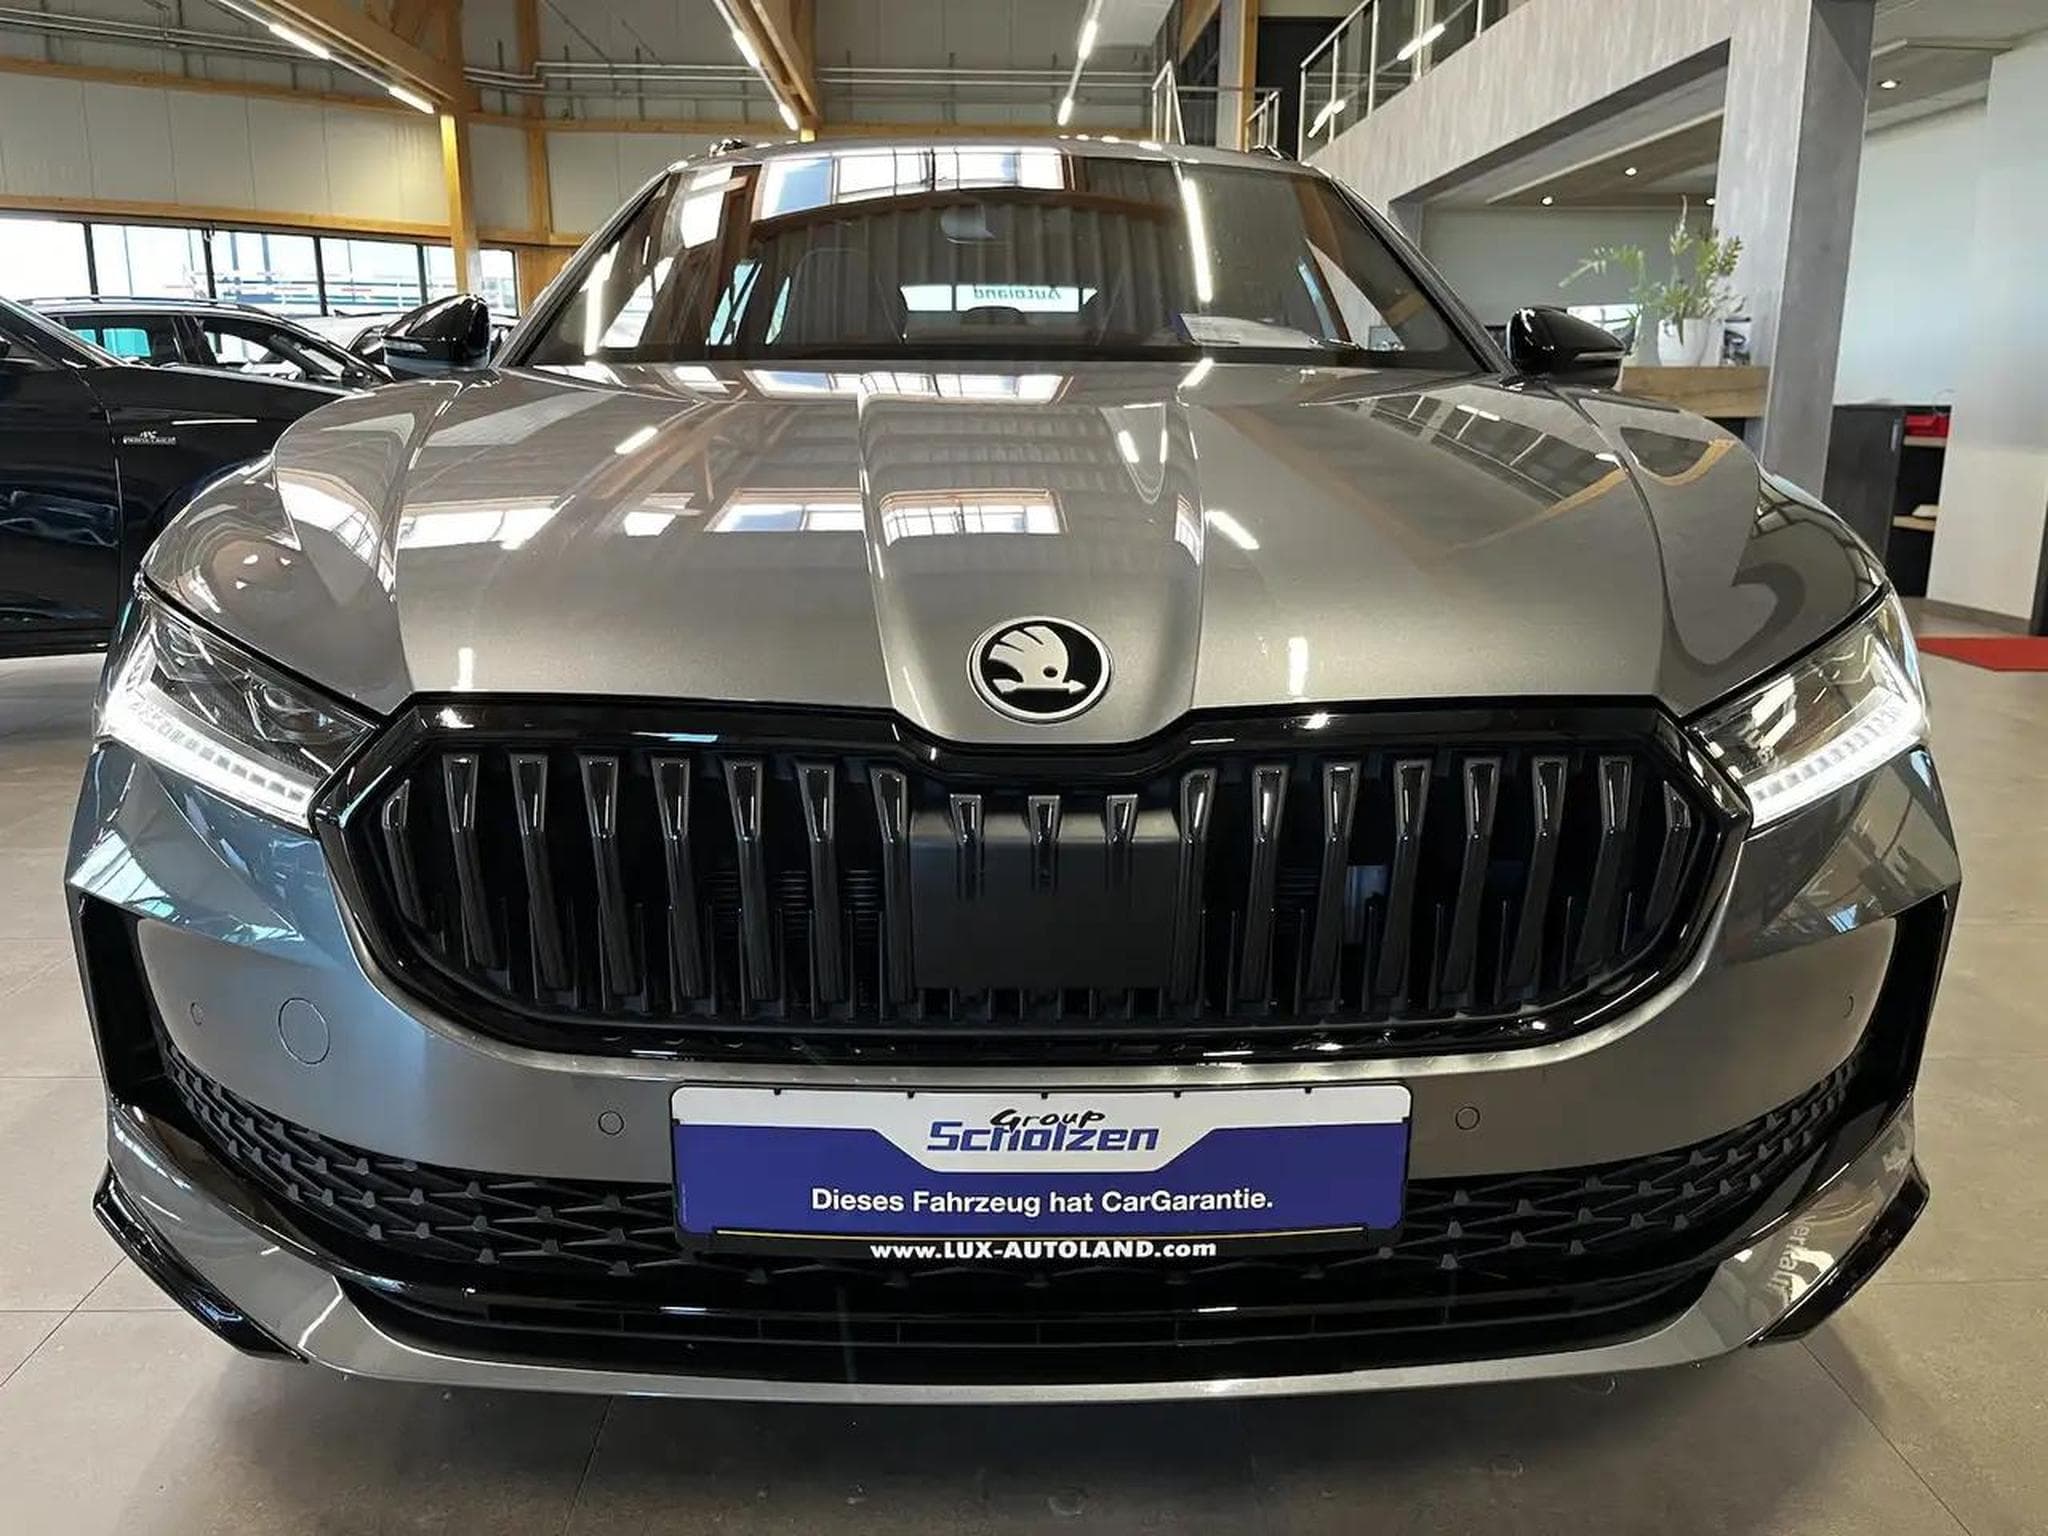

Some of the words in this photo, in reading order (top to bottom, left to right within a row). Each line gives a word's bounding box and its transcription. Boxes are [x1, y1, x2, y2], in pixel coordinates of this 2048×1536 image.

[990, 1109, 1106, 1131] Group
[927, 1121, 1160, 1151] Scholzen
[811, 1187, 904, 1211] Dieses
[913, 1190, 1041, 1217] Fahrzeug
[1049, 1191, 1093, 1213] hat
[1101, 1188, 1273, 1213] CarGarantie.
[870, 1240, 1217, 1259] www.LUX-AUTOLAND.com
